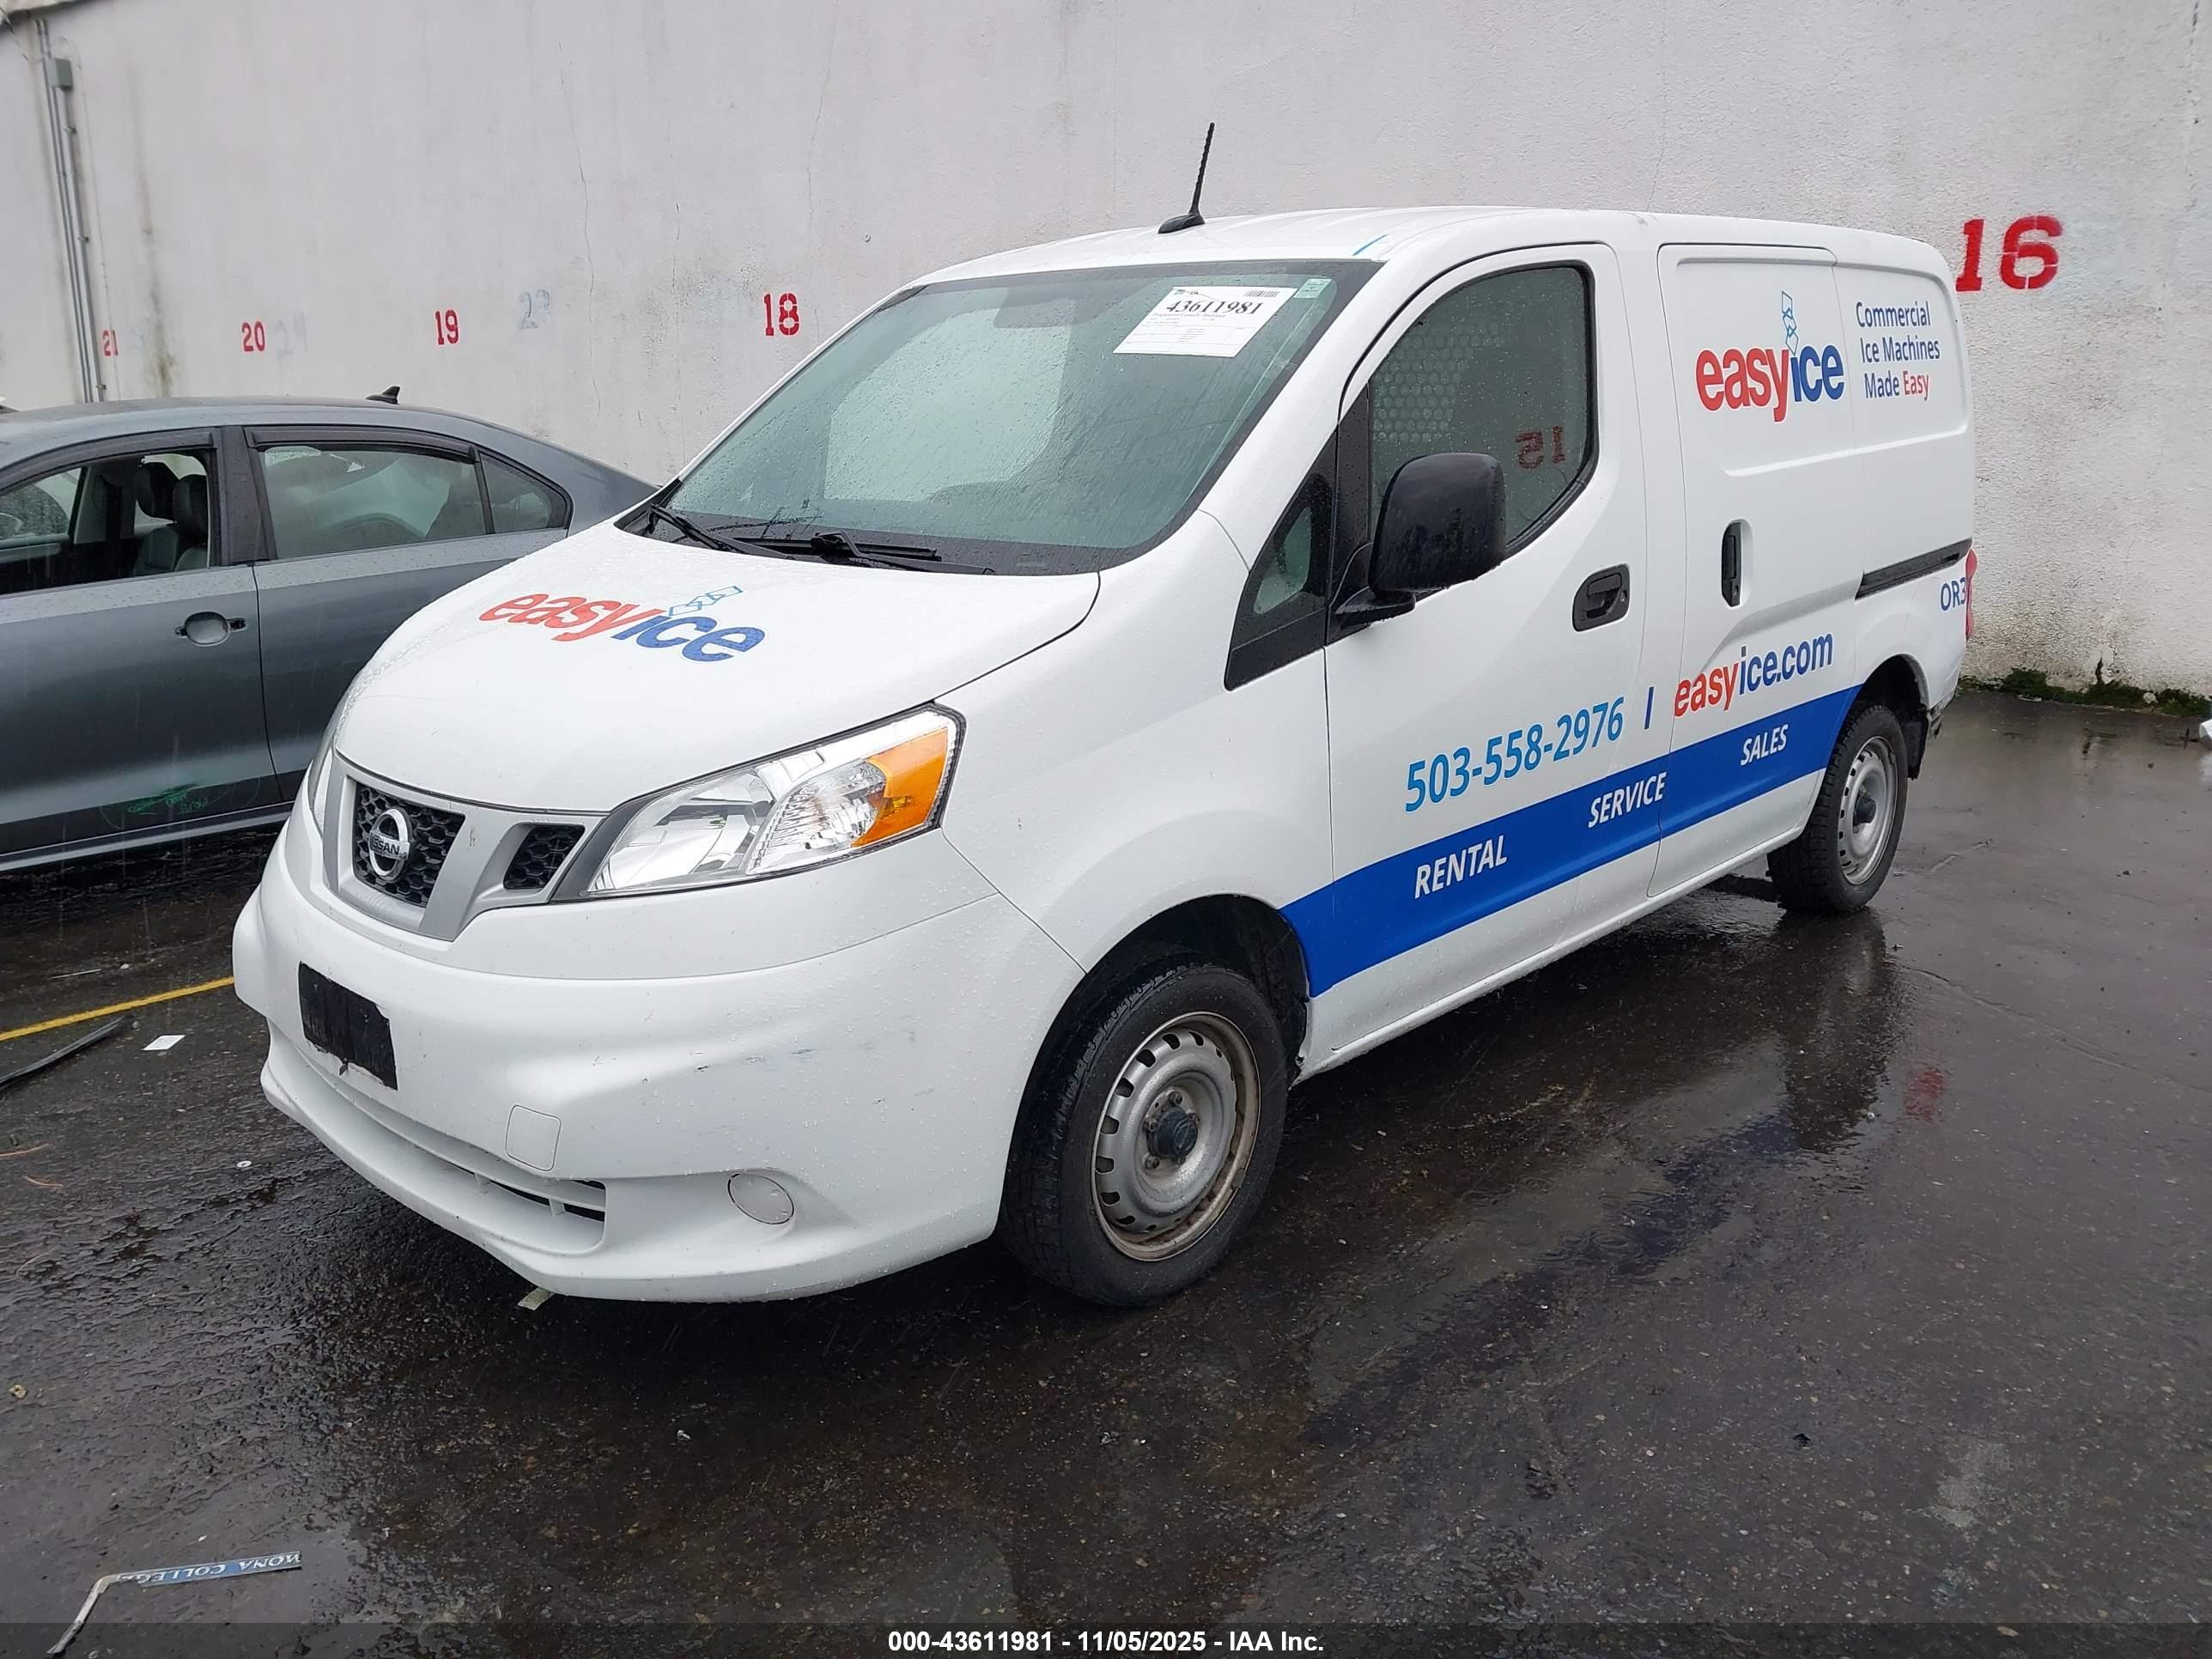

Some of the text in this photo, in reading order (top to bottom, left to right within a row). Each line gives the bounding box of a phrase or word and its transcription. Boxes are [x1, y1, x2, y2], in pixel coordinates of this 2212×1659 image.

[1955, 215, 2063, 292] 16
[434, 309, 459, 345] 19
[763, 291, 799, 337] 18
[1166, 301, 1263, 314] 43611981
[1856, 301, 1931, 328] Commercial
[102, 330, 118, 356] 21
[241, 321, 265, 352] 20
[1860, 334, 1941, 363] Ice Machines
[1695, 344, 1845, 422] easyice
[1864, 370, 1930, 401] Made Easy
[1941, 577, 1966, 611] OR3
[478, 593, 766, 663] easyice
[1404, 695, 1626, 812] 503-558-2976
[1674, 632, 1834, 717] easyice.com
[1740, 723, 1790, 767] SALES
[1587, 771, 1668, 829] SERVICE
[1414, 835, 1508, 900] RENTAL
